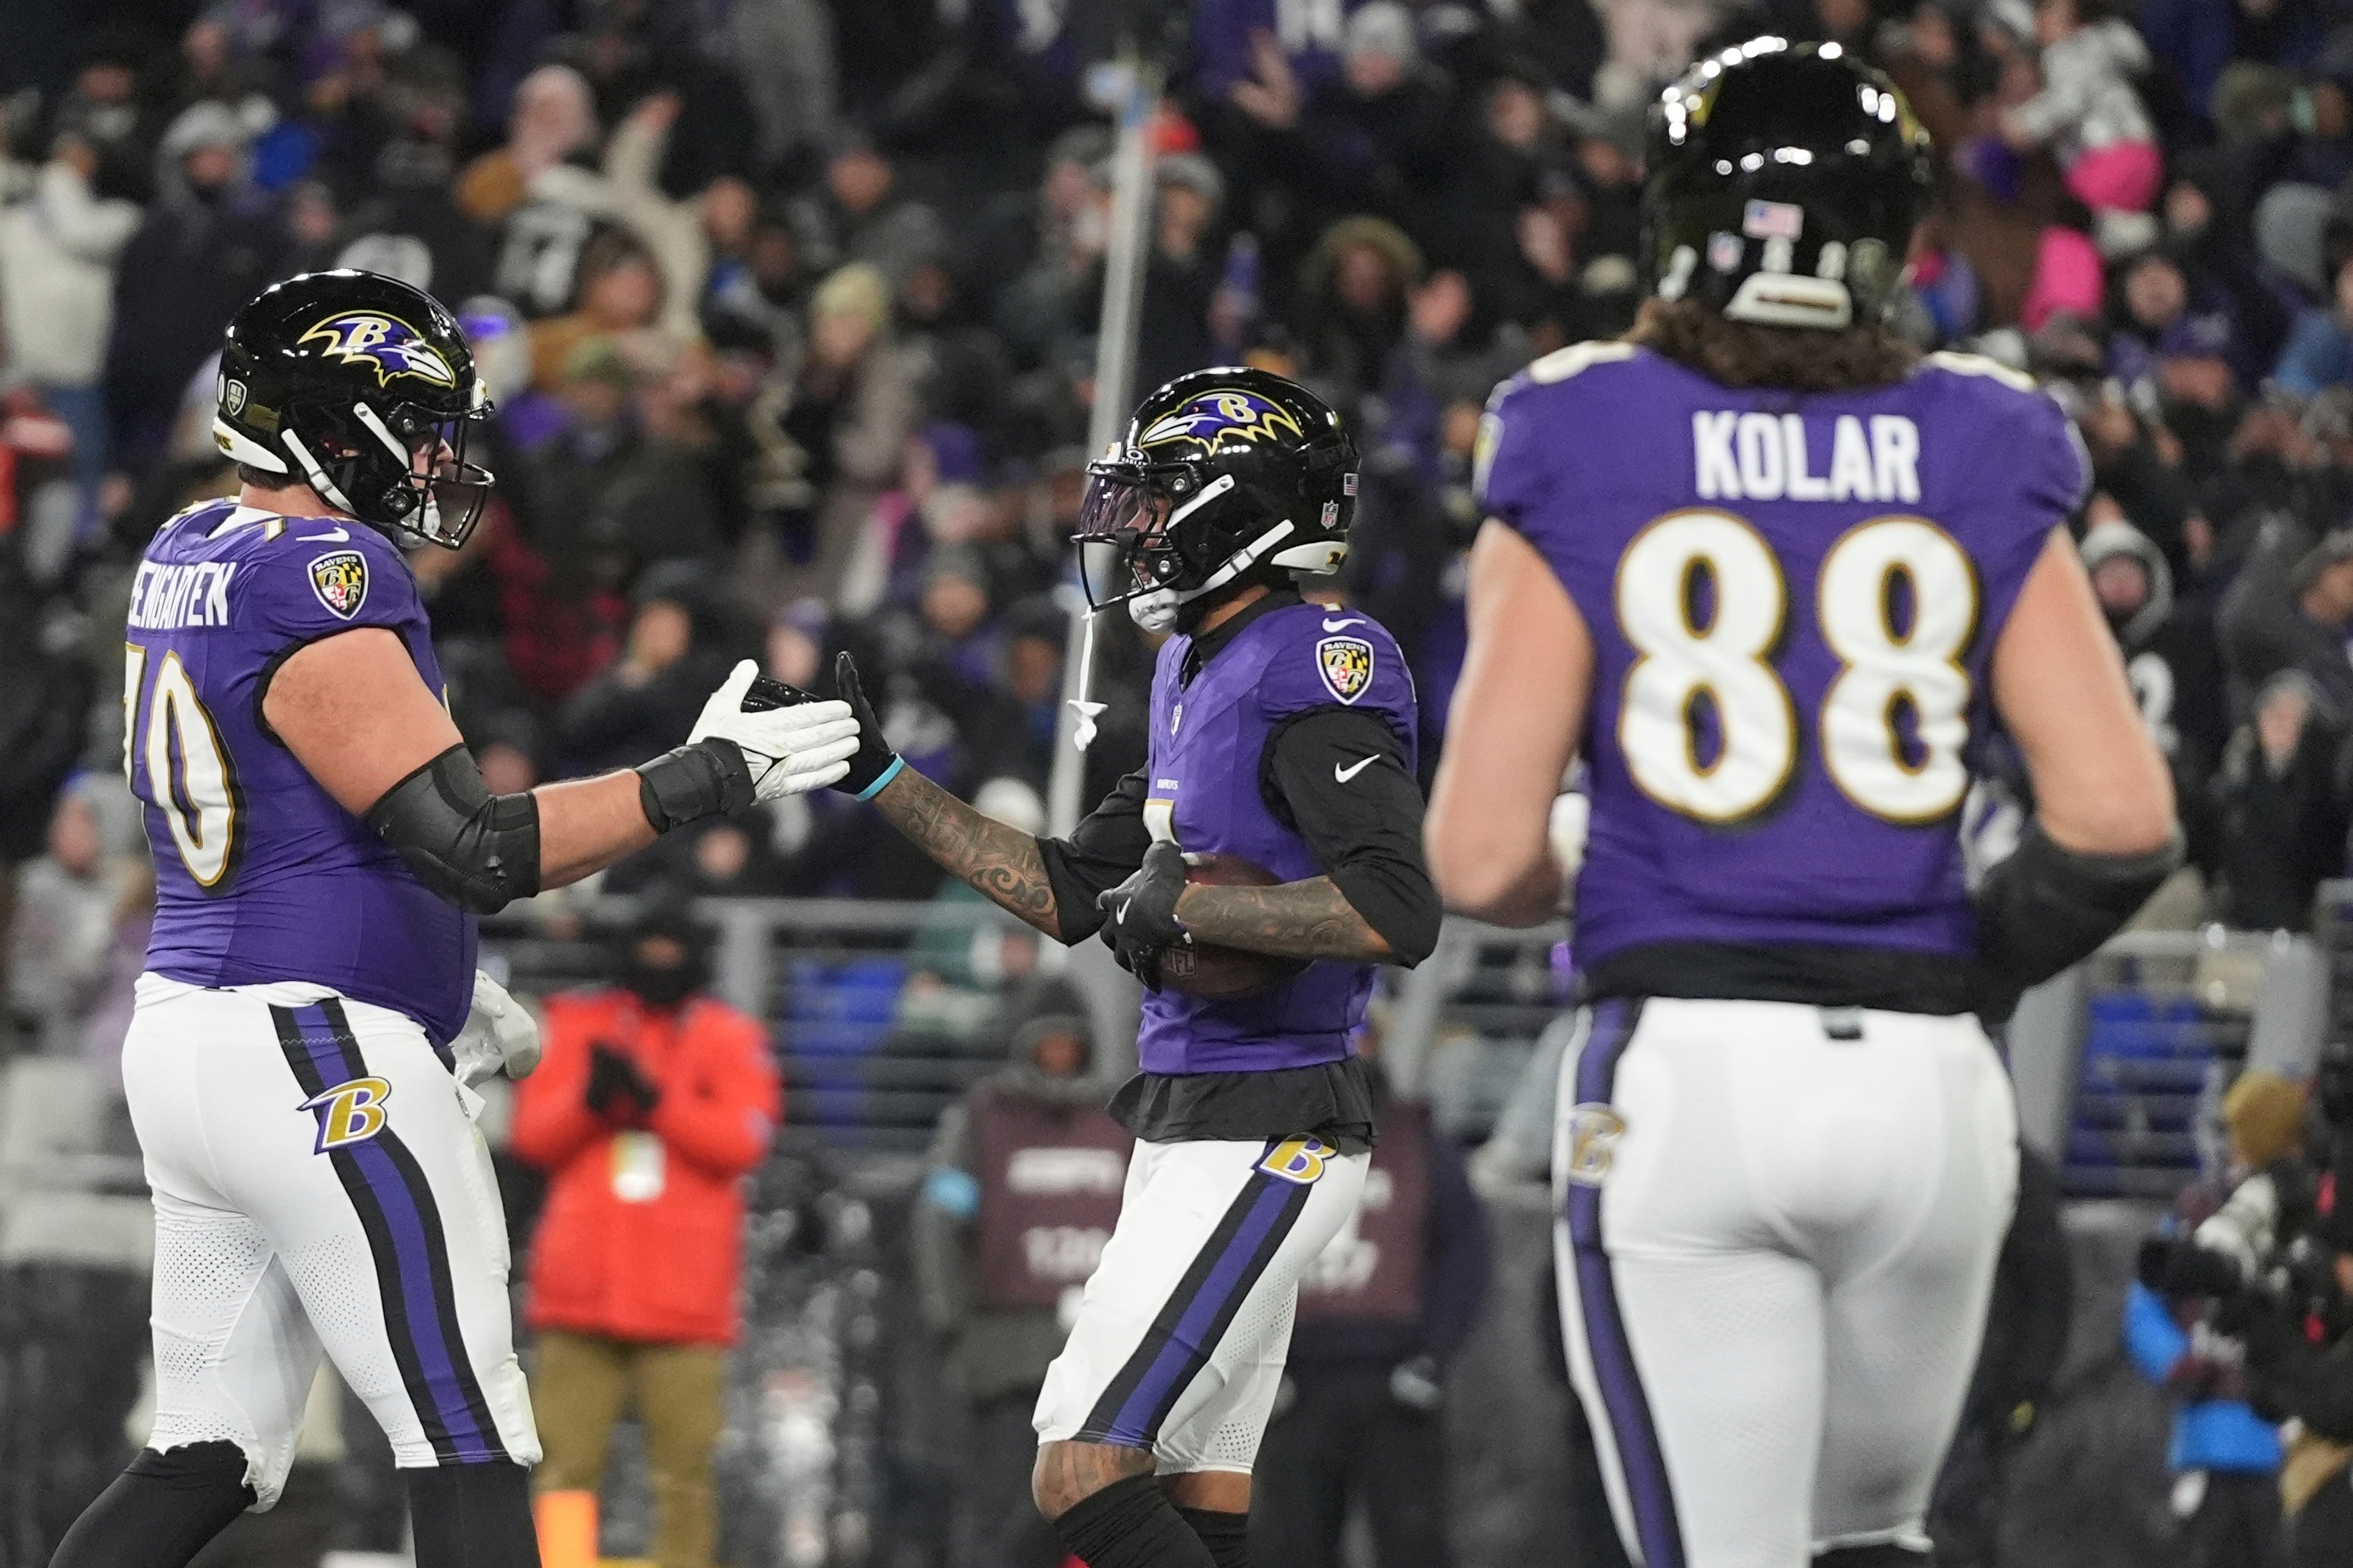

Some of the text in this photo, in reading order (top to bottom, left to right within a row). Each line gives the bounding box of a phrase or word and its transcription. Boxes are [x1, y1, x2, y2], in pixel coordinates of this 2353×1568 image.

[1691, 410, 1921, 504] KOLAR
[314, 555, 357, 572] RAVENS
[1324, 641, 1368, 653] RAVENS
[1614, 507, 1981, 824] 88
[295, 1076, 392, 1155] B
[1250, 1131, 1340, 1186] B
